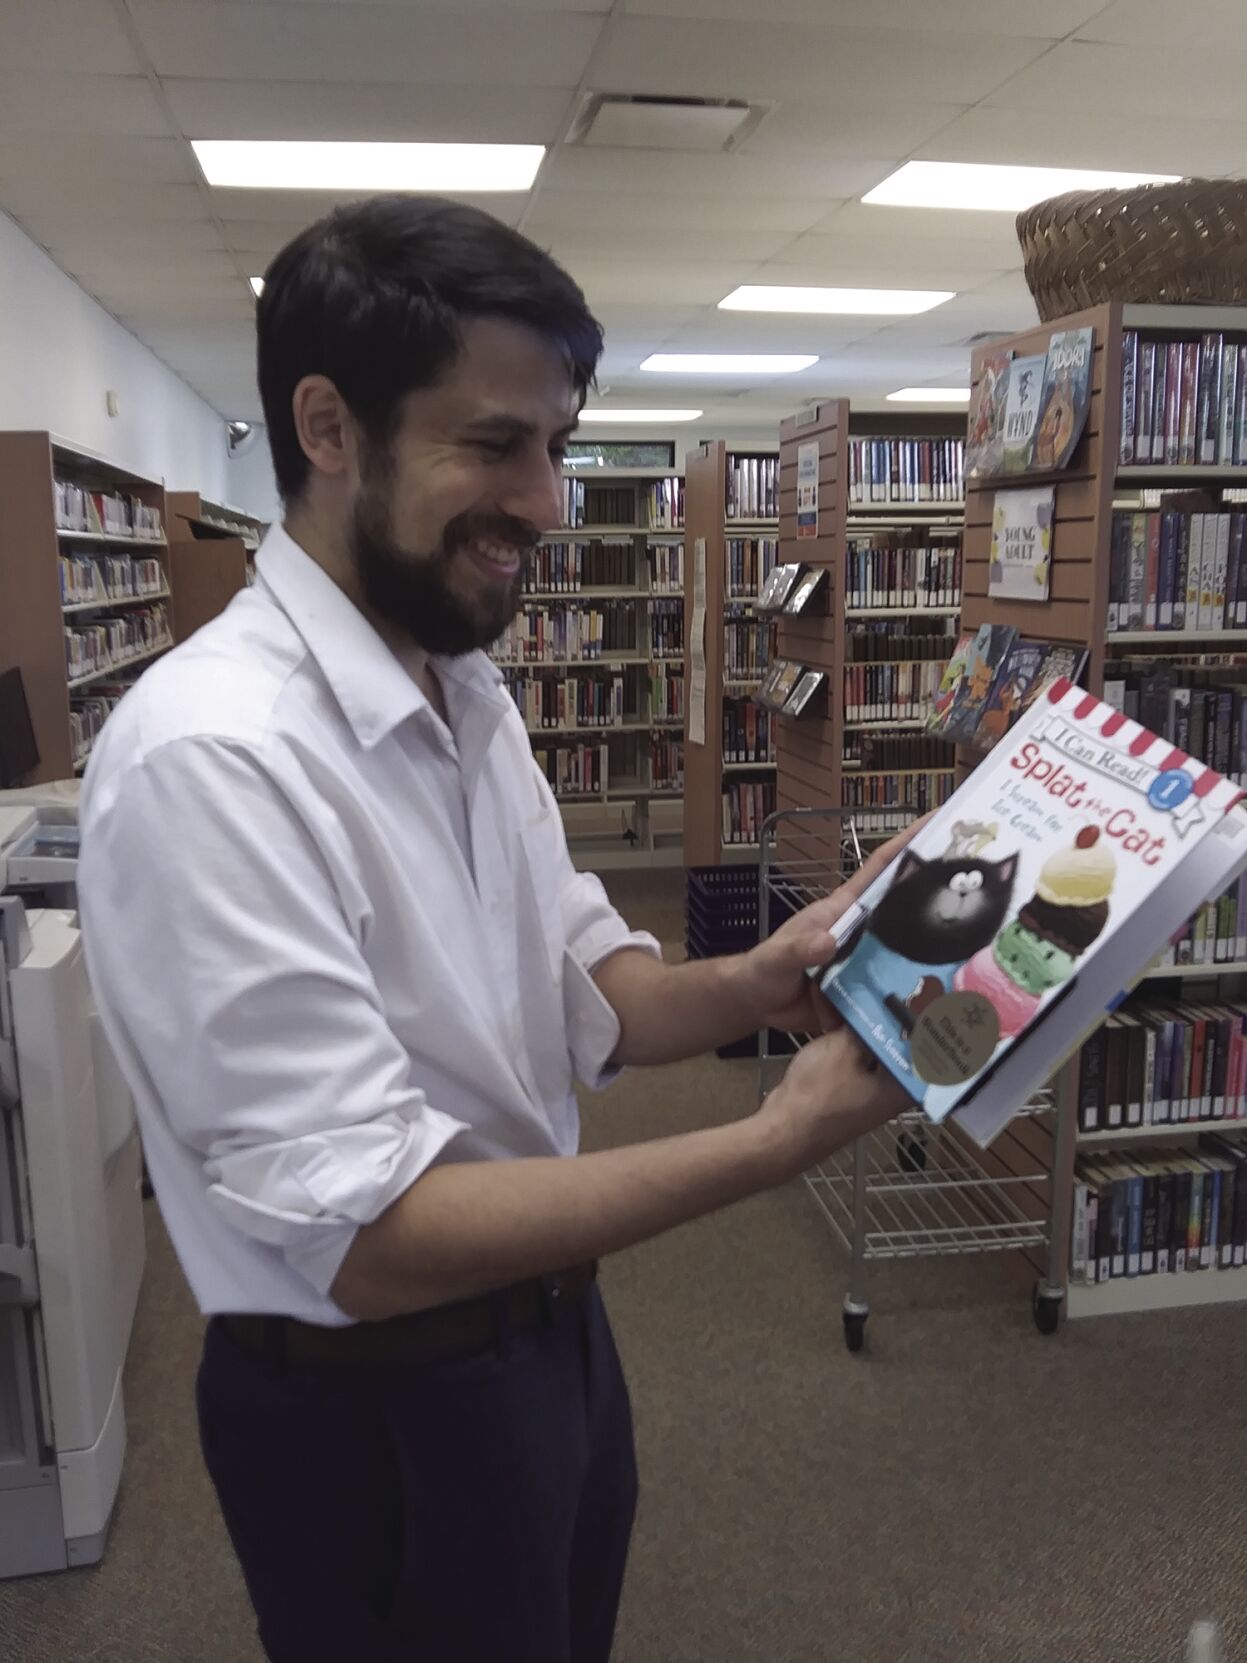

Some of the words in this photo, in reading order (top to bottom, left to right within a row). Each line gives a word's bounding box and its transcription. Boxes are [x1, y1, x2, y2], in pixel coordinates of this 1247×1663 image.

[1055, 728, 1069, 743] I
[1063, 734, 1095, 764] Can
[1099, 751, 1149, 785] Read!
[1010, 742, 1088, 808] Splat
[1083, 797, 1111, 817] the
[1104, 808, 1168, 866] Cat
[1160, 778, 1181, 799] 1
